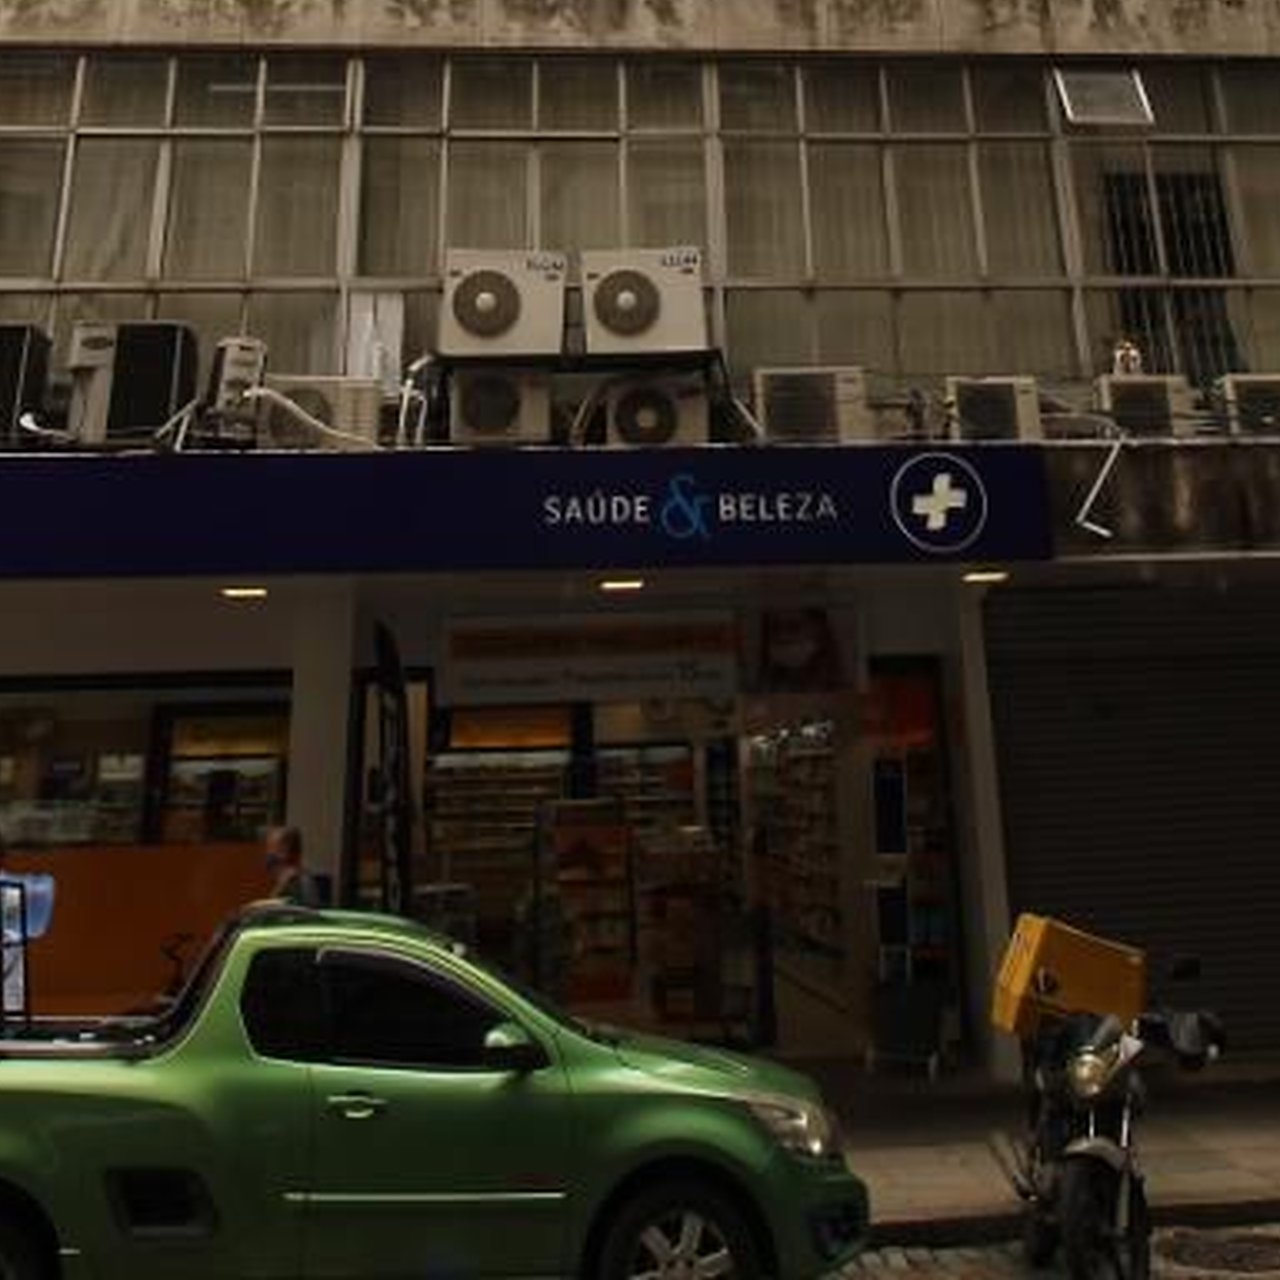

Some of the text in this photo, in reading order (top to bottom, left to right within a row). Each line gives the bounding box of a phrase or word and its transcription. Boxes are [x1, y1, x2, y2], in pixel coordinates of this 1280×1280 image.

[543, 474, 838, 538] SAÚDE & BELEZA
